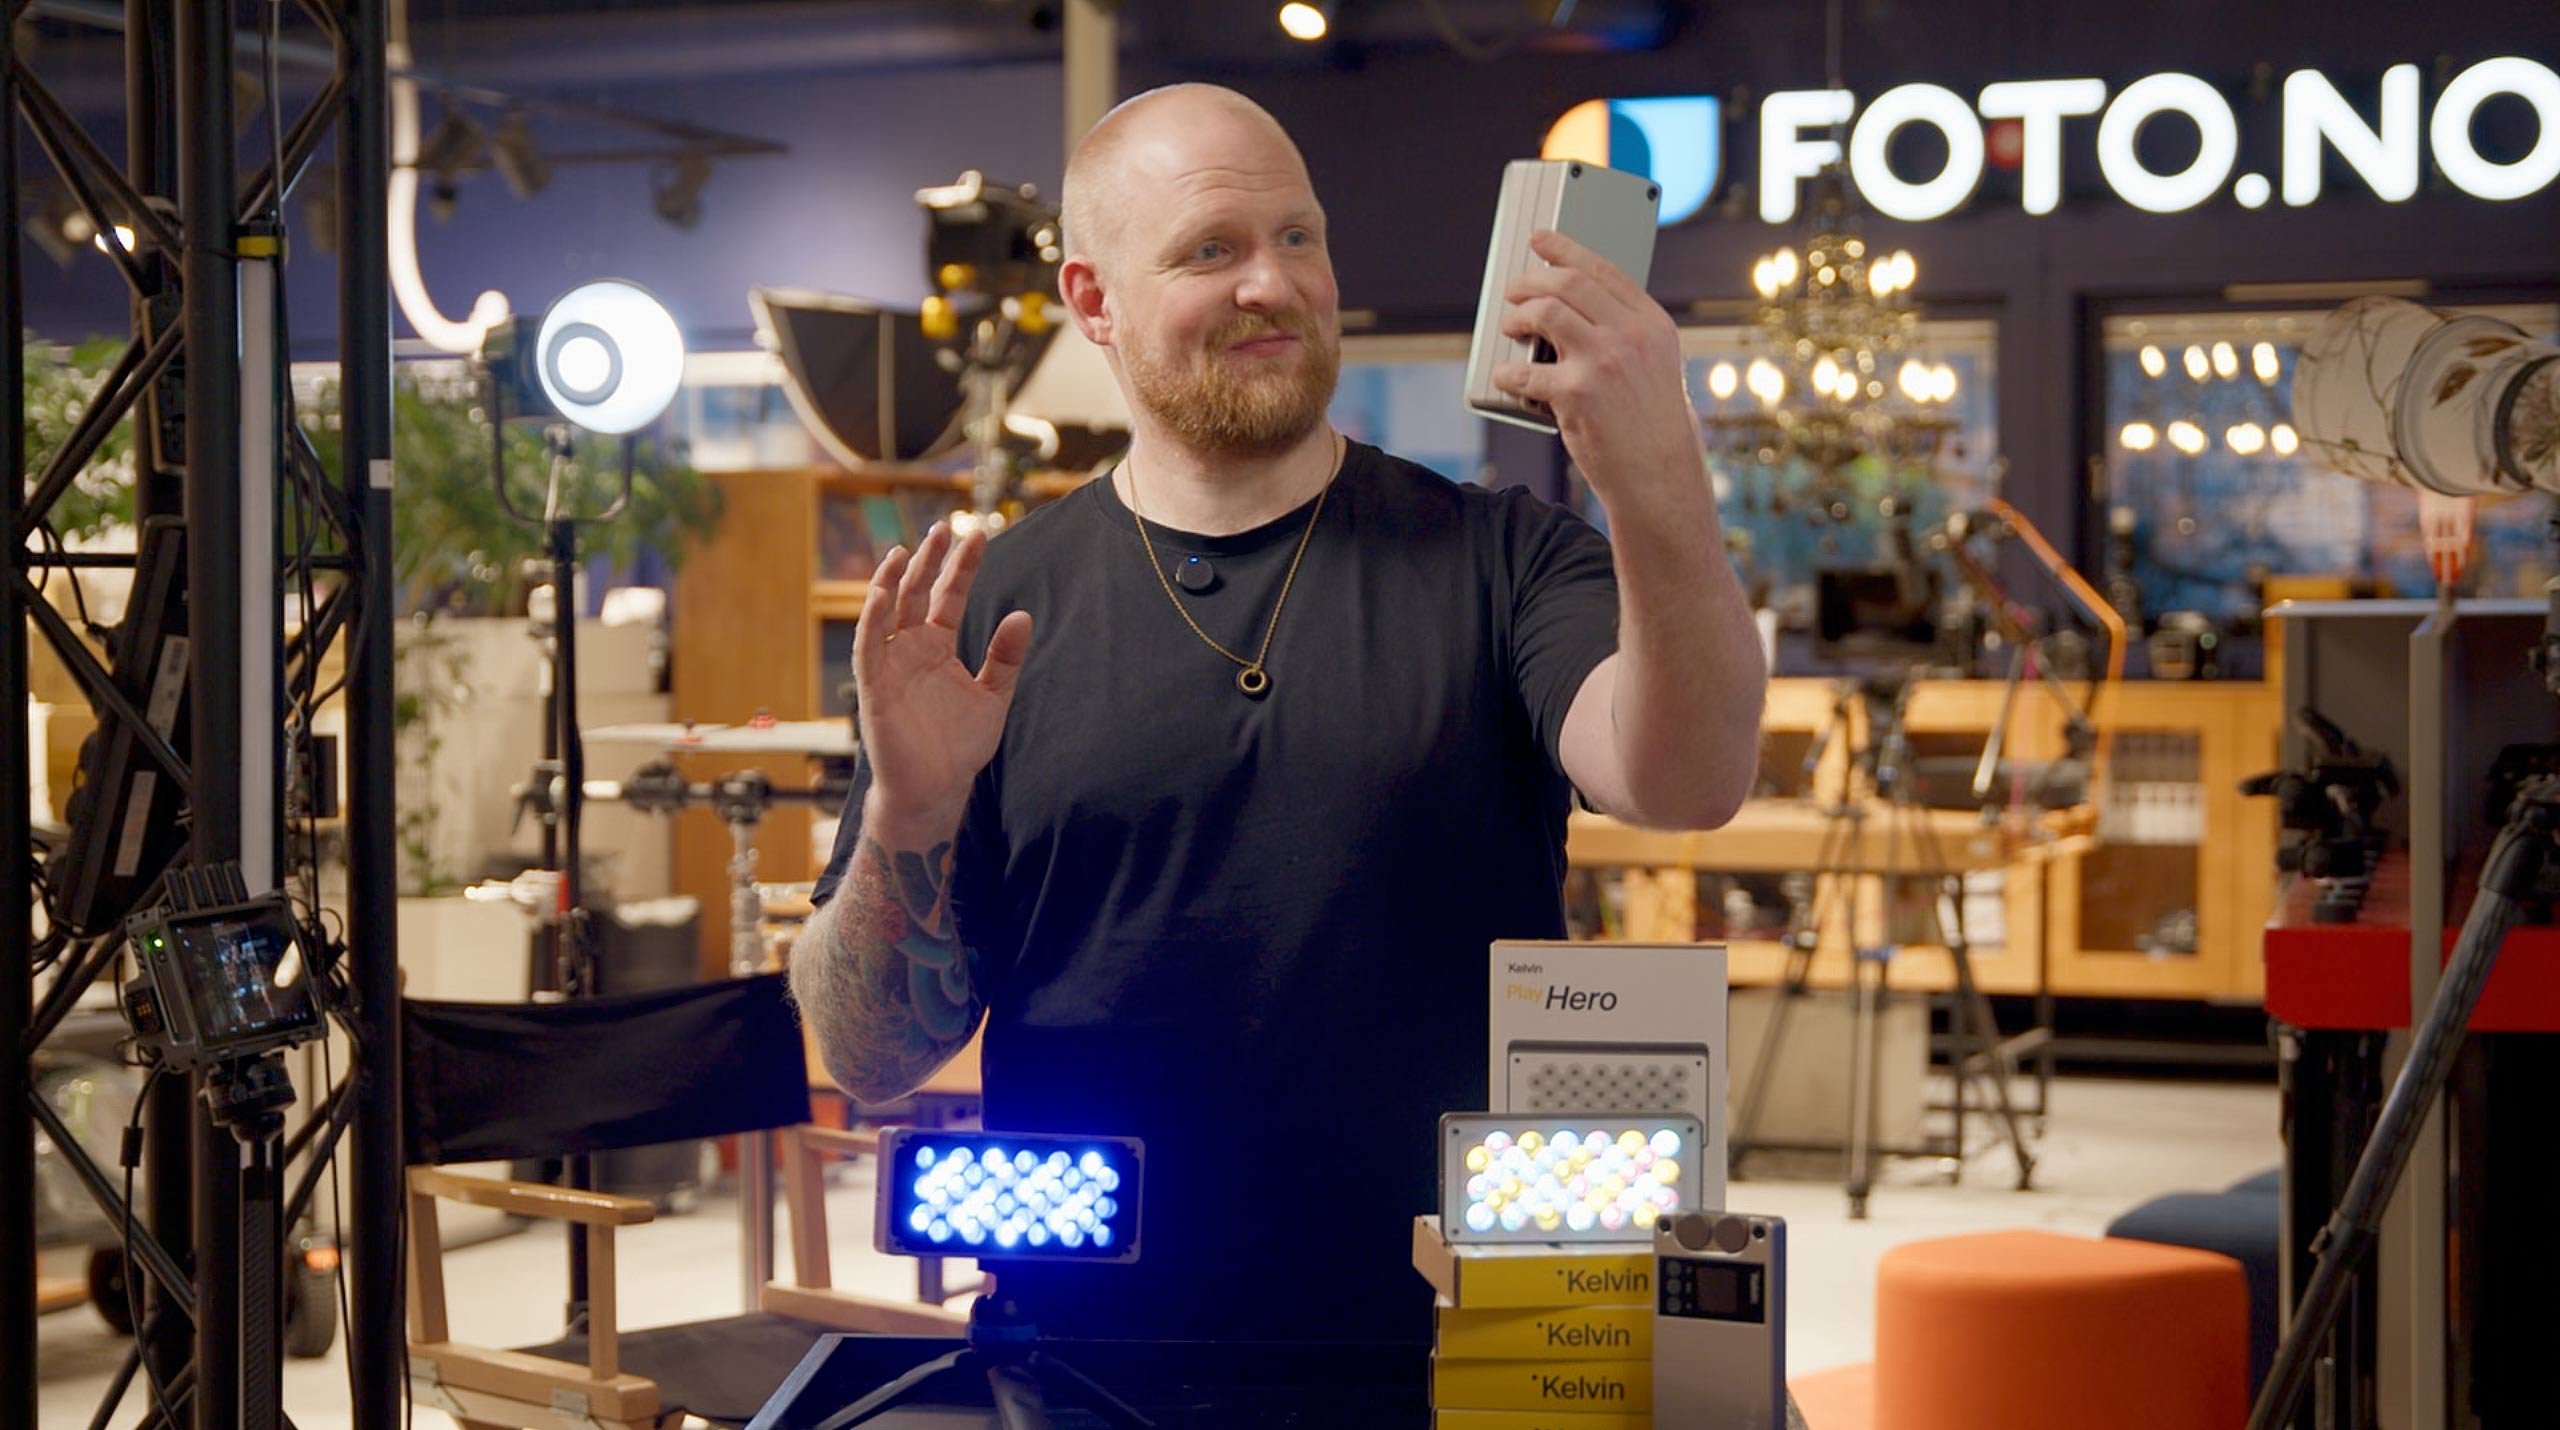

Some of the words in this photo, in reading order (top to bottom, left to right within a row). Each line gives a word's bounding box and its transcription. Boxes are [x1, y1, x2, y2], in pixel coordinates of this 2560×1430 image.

[1760, 56, 2560, 224] FOTO.NO
[1507, 962, 1544, 975] Kelvin
[1505, 983, 1542, 1003] Play
[1545, 985, 1617, 1011] Hero
